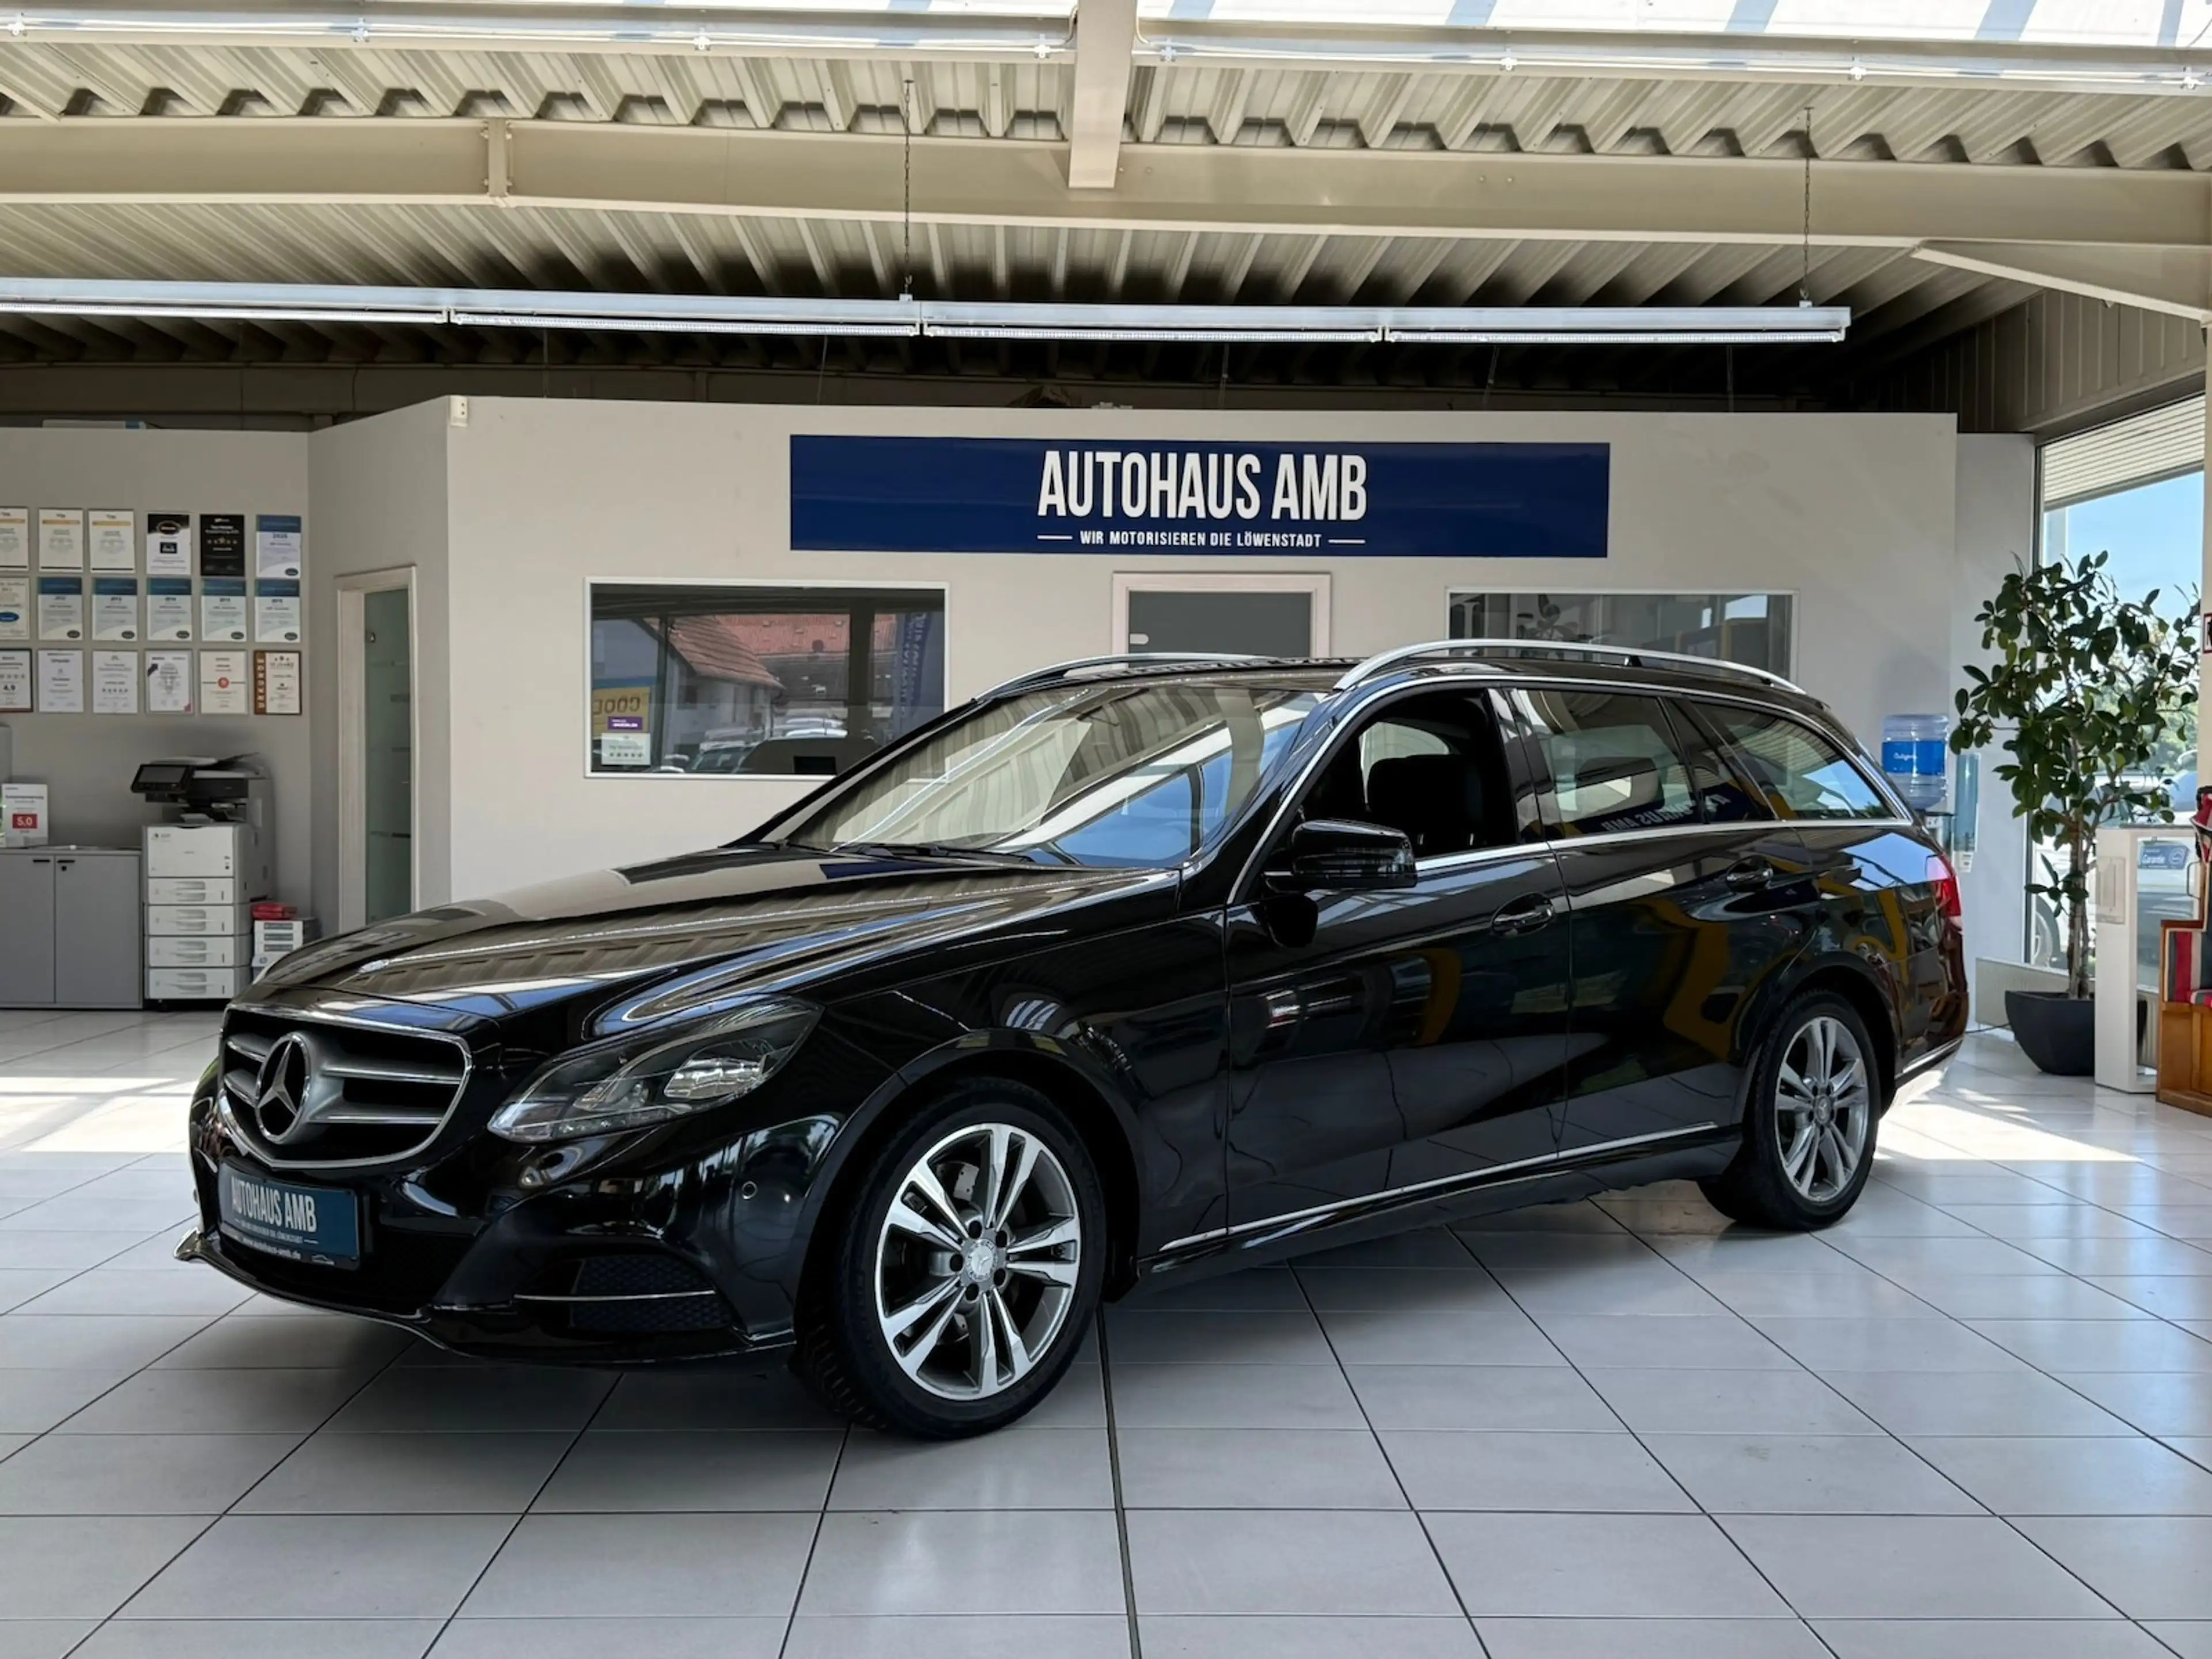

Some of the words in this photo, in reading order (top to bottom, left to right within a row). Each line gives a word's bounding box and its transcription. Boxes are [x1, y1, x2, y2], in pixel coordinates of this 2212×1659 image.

[1037, 450, 1260, 520] AUTOHAUS
[1271, 453, 1366, 521] AMB
[1080, 531, 1104, 545] WIR
[1109, 531, 1206, 546] MOTORISIEREN
[1210, 532, 1232, 547] DIE
[1237, 531, 1321, 547] LÖWENSTADT
[231, 1176, 282, 1227] AUTOHAUS
[285, 1191, 317, 1233] AMB
